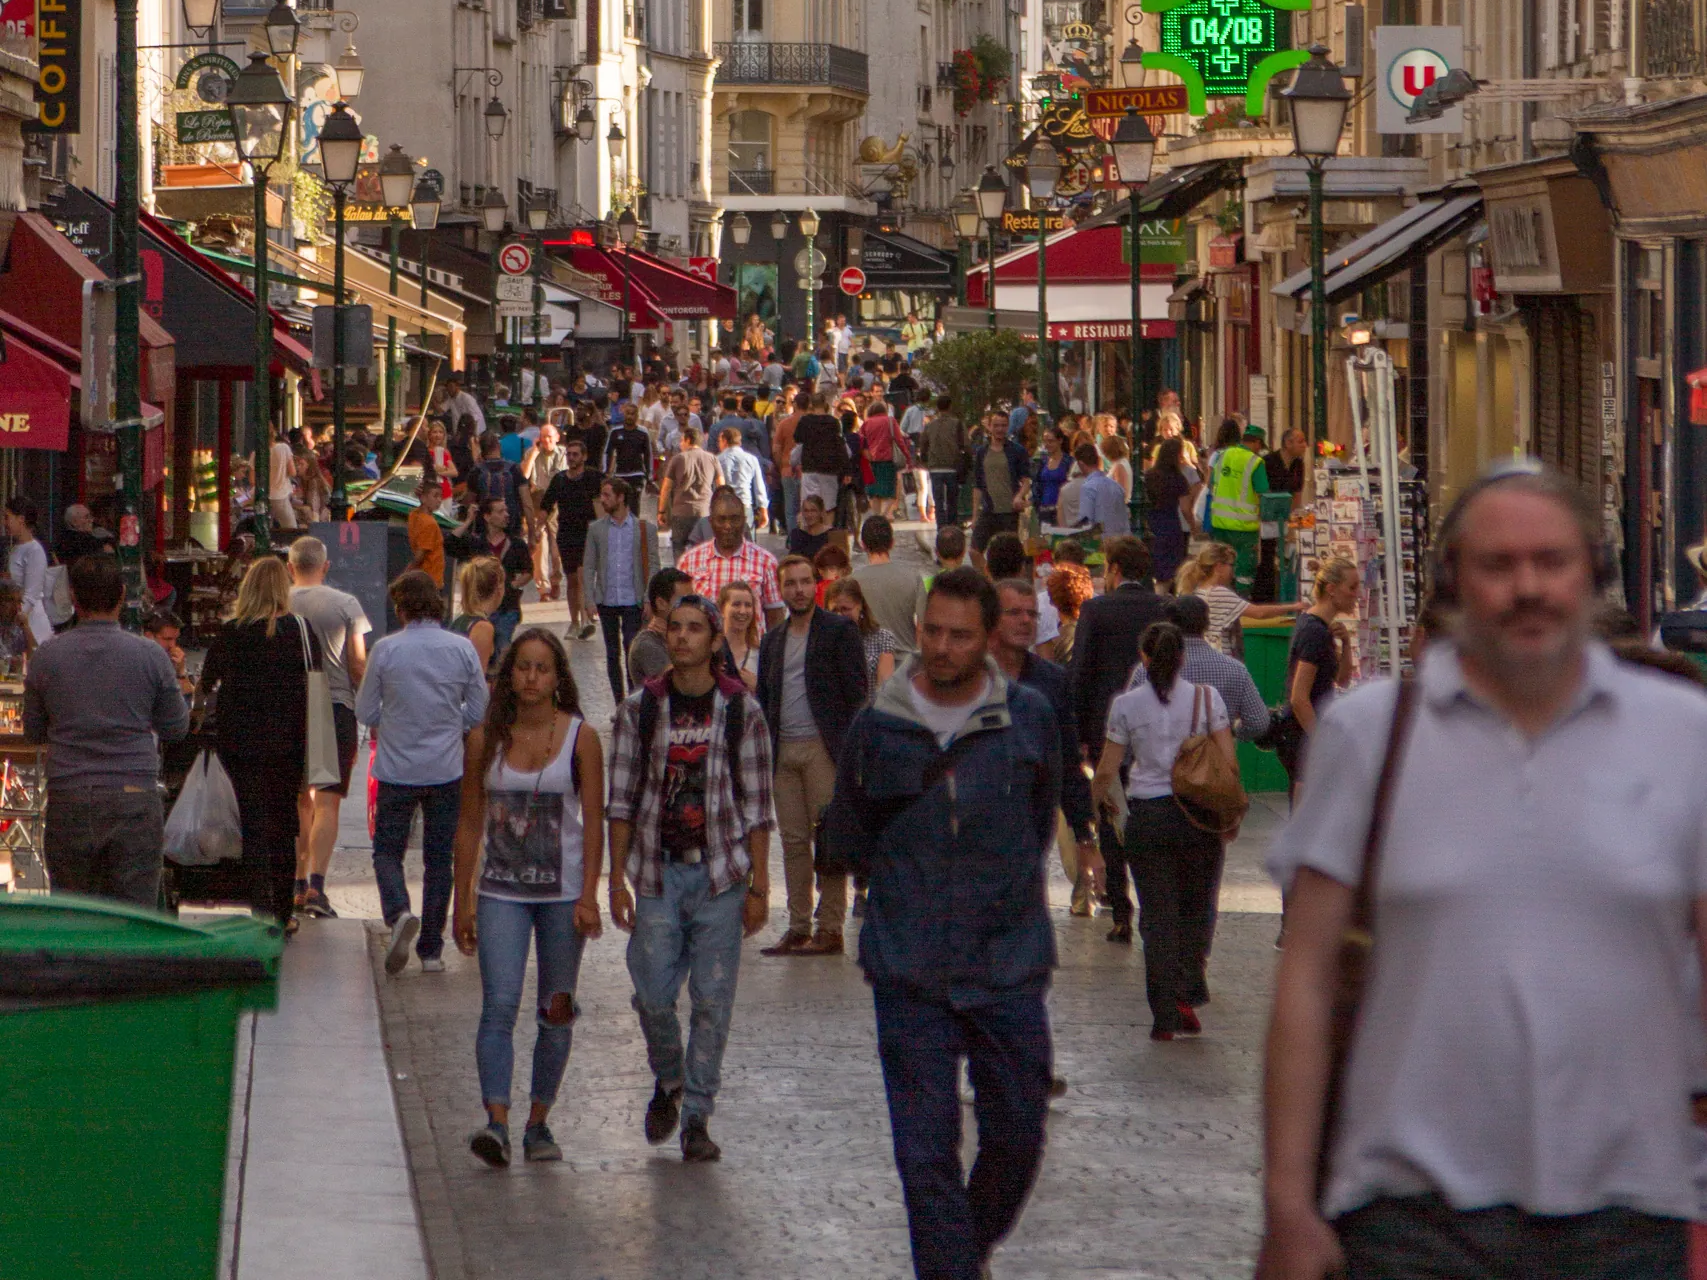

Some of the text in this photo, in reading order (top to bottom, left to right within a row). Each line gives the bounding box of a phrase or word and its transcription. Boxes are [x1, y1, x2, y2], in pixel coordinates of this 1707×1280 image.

[1190, 17, 1263, 45] 04/08
[1403, 66, 1436, 96] U
[1096, 91, 1179, 111] NICOLAS
[66, 222, 89, 237] Jeff
[1074, 324, 1149, 338] RESTAURAT
